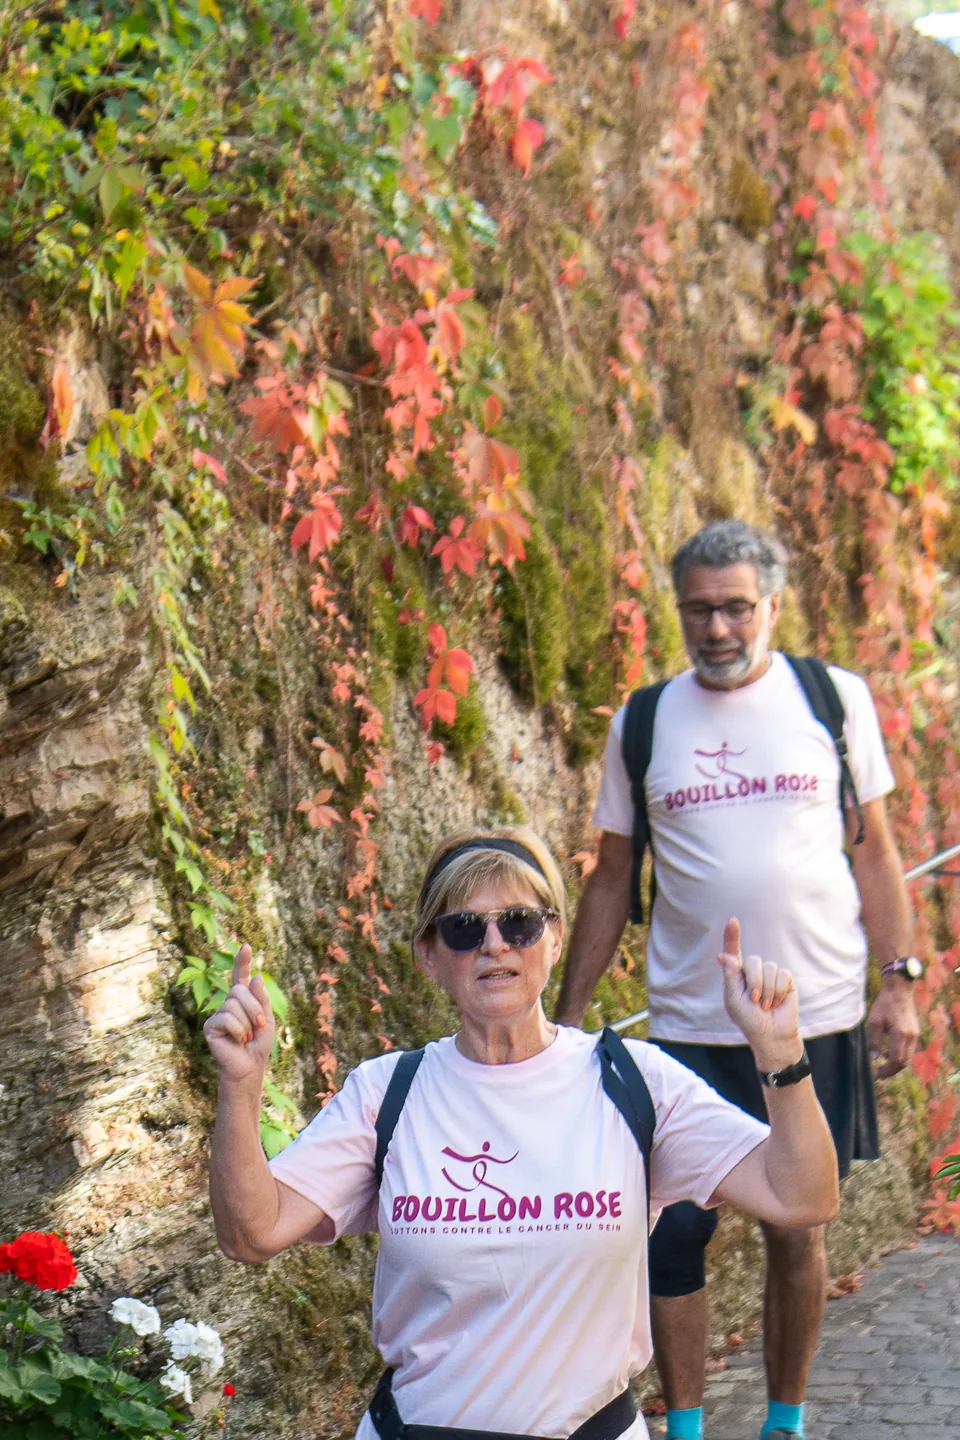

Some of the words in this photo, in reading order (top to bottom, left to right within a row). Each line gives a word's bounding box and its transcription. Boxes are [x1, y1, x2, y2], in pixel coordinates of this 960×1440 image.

[664, 776, 766, 810] BOUILLON
[775, 774, 818, 793] ROSE
[392, 1195, 542, 1222] BOUILLON
[554, 1190, 622, 1219] ROSE
[442, 1226, 492, 1235] CONTRE
[498, 1226, 512, 1234] LE
[518, 1223, 570, 1233] CANCER
[576, 1223, 593, 1231] DU
[598, 1223, 621, 1232] SEIN
